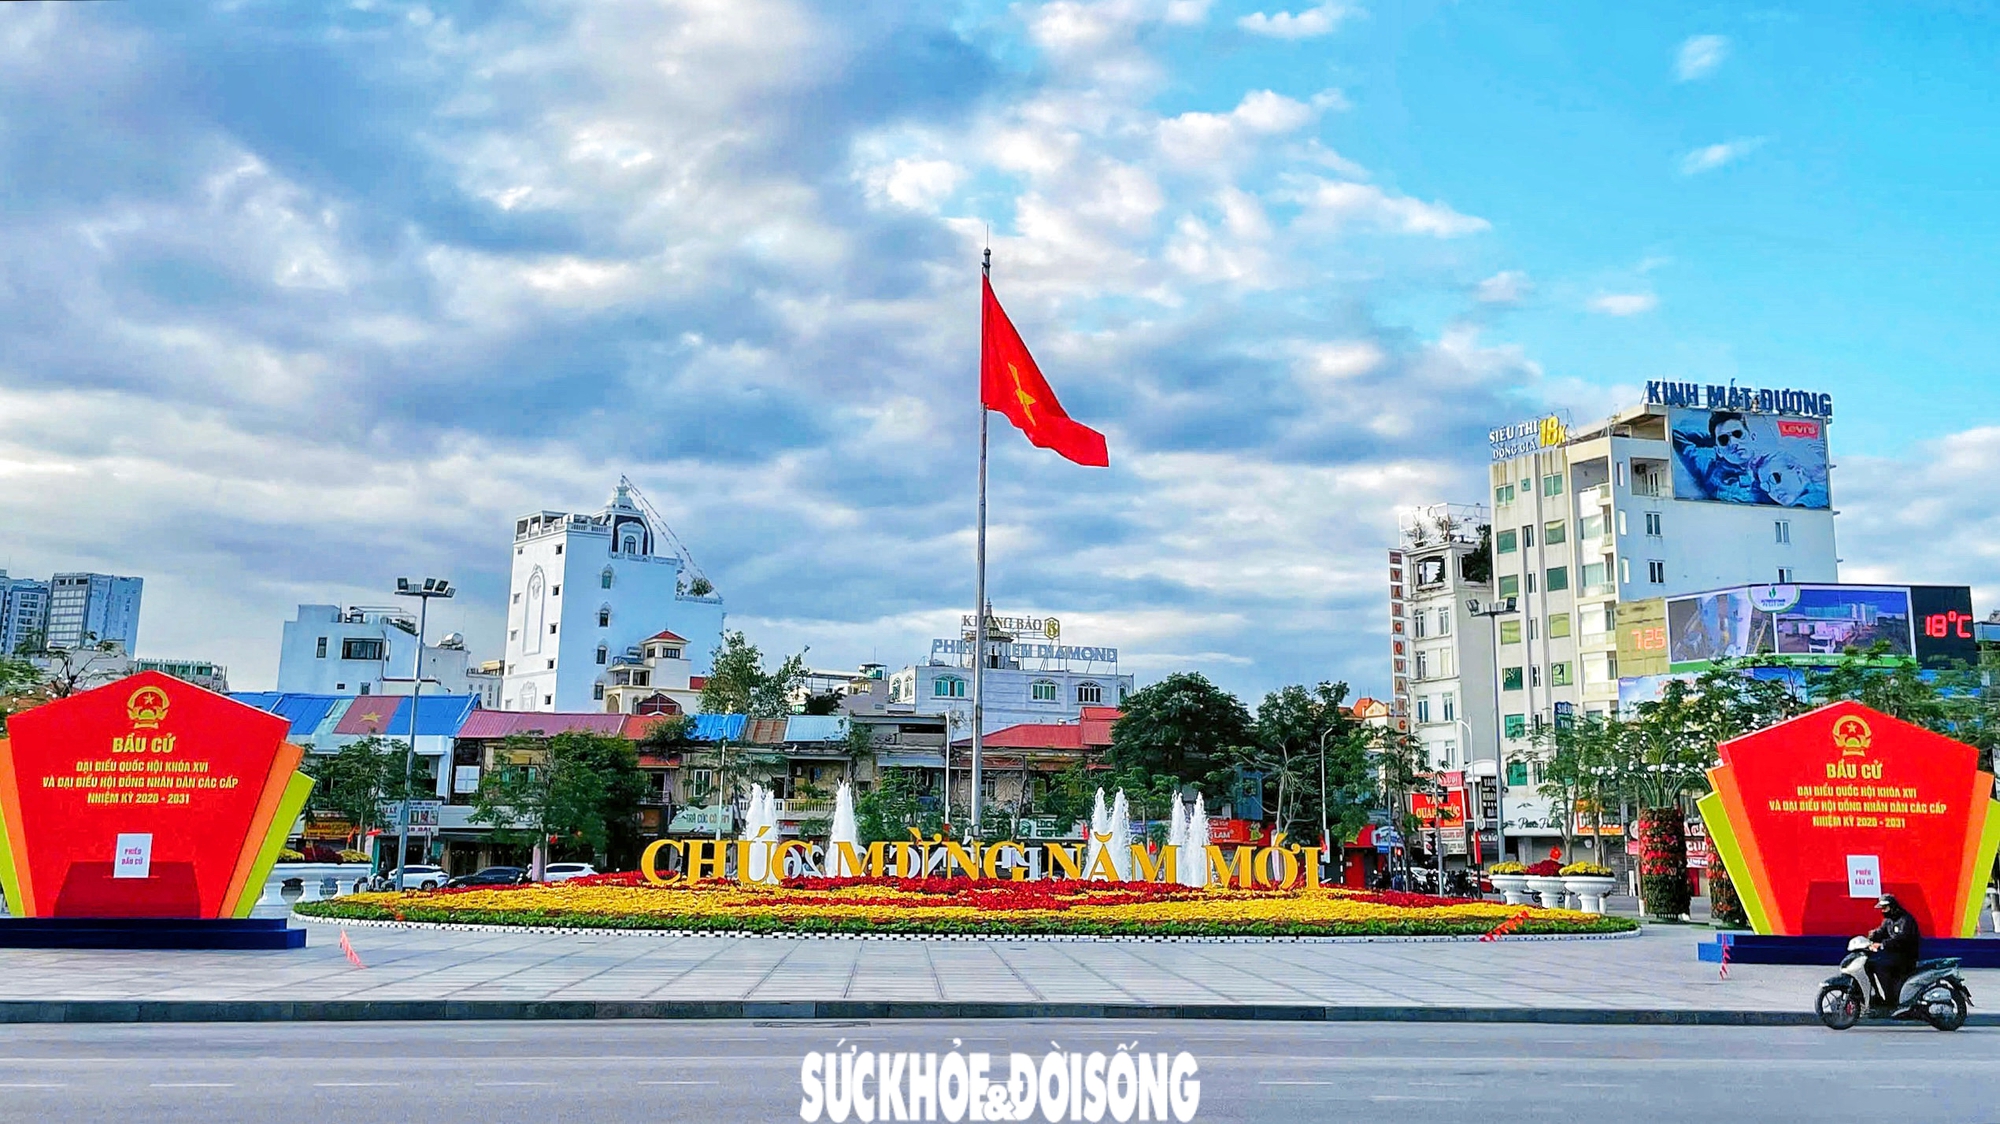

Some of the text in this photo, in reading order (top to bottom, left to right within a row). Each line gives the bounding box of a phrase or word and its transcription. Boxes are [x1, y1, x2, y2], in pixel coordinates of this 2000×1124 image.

[1038, 645, 1118, 662] DIAMOND
[151, 733, 176, 753] CỬ
[119, 758, 144, 773] QUỐC
[146, 760, 163, 774] HỘI
[193, 761, 209, 773] XVI
[1861, 760, 1883, 779] CỬ
[43, 775, 55, 788] VÀ
[100, 776, 116, 790] HỘI
[147, 776, 173, 788] NHÂN
[176, 775, 196, 788] DÂN
[198, 776, 217, 789] CÁC
[219, 774, 239, 789] CẤP
[87, 791, 119, 806] NHIỆM
[121, 791, 134, 804] KỲ
[167, 793, 190, 805] 2031
[1836, 784, 1859, 797] QUỐC
[1861, 785, 1876, 799] HỘI
[1902, 788, 1917, 798] XVI
[1769, 799, 1781, 811] VÀ
[1910, 802, 1927, 814] CÁC
[641, 826, 1323, 889] CHÚC MỪNG NĂM MỚI
